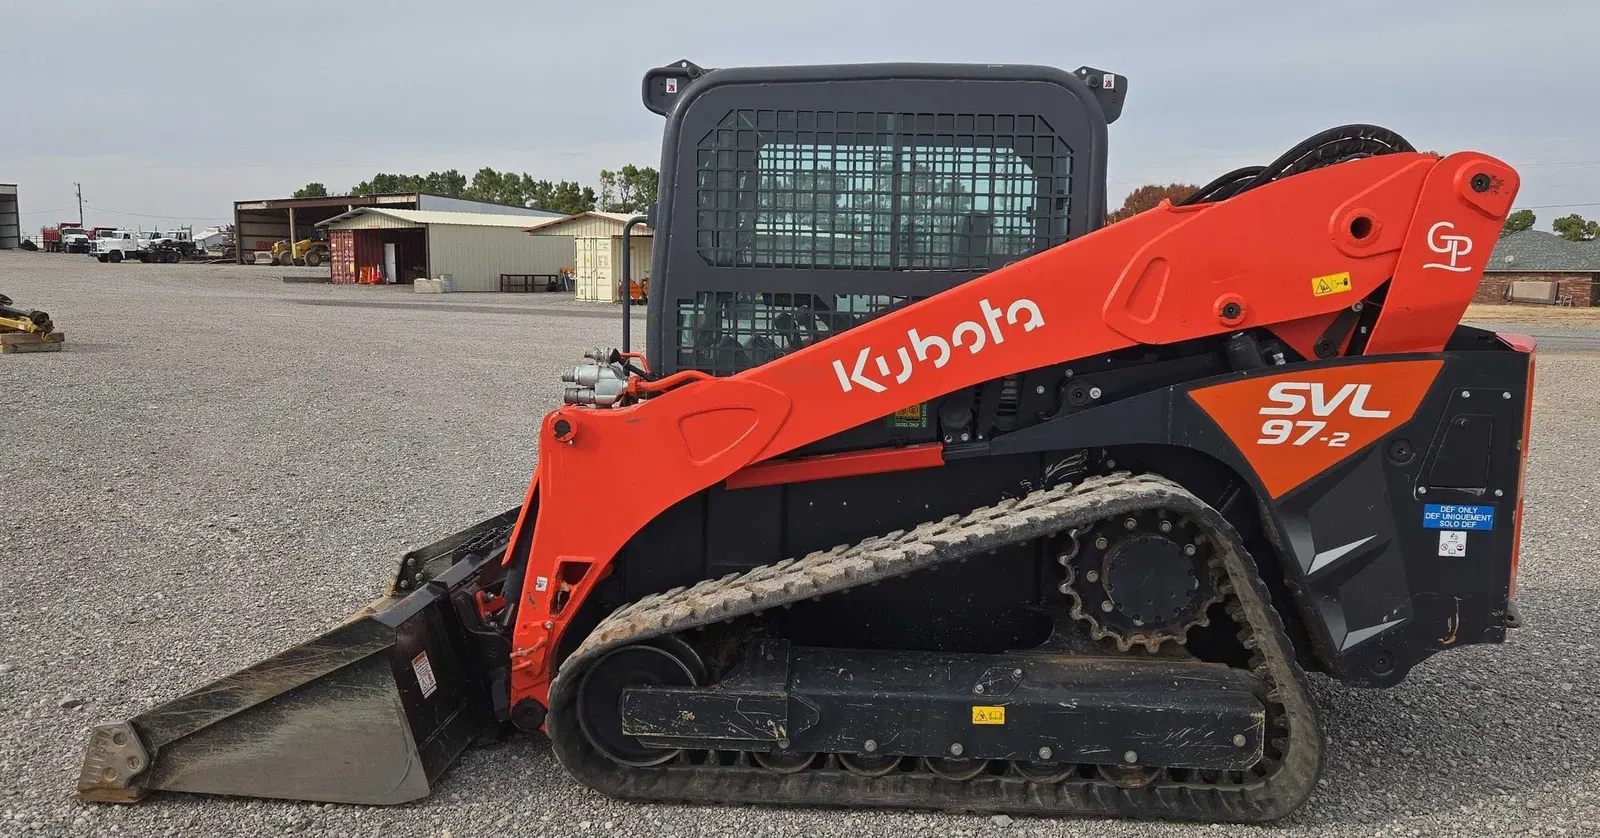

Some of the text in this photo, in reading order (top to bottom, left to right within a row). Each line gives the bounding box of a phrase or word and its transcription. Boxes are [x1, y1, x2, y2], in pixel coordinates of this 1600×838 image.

[832, 298, 1045, 393] Kubota
[1258, 382, 1391, 418] SVL
[1256, 419, 1350, 447] 97-2
